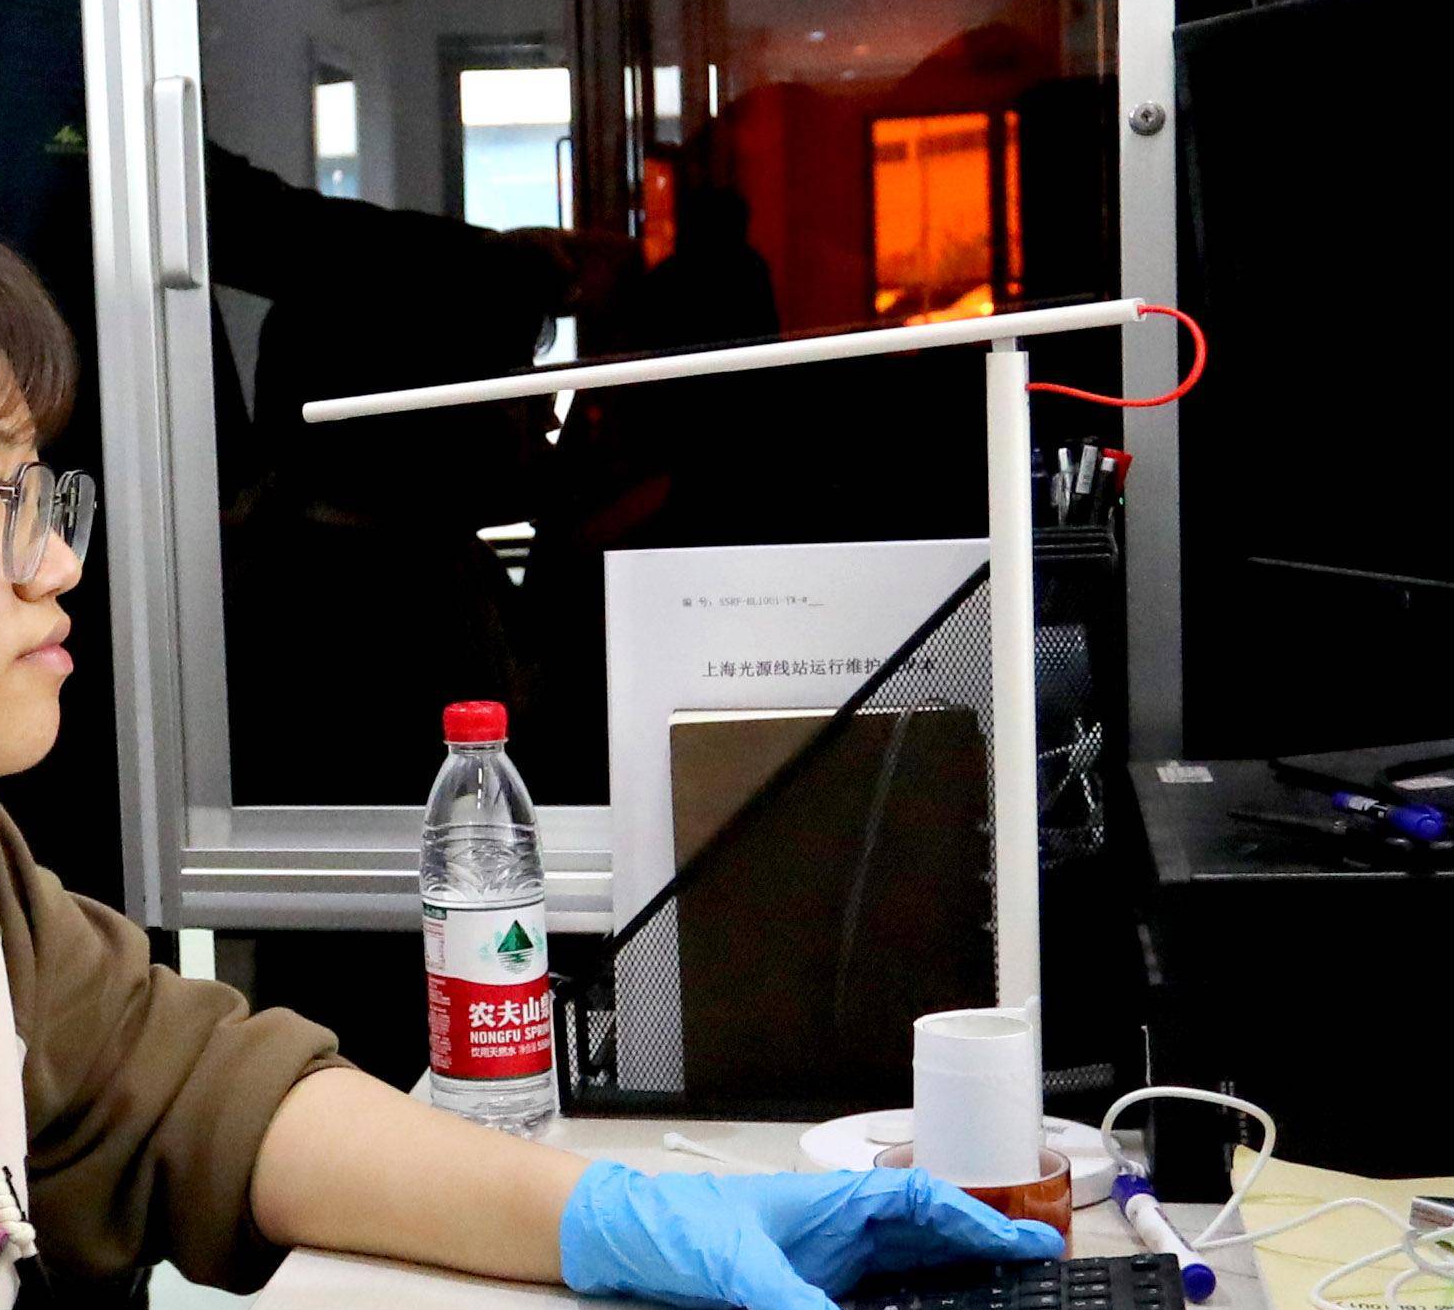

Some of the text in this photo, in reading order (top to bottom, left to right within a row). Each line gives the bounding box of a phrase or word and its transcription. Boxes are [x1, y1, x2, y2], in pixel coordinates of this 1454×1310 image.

[702, 656, 937, 678] 上海光源线站运行维护
[470, 1029, 521, 1045] NONGFU
